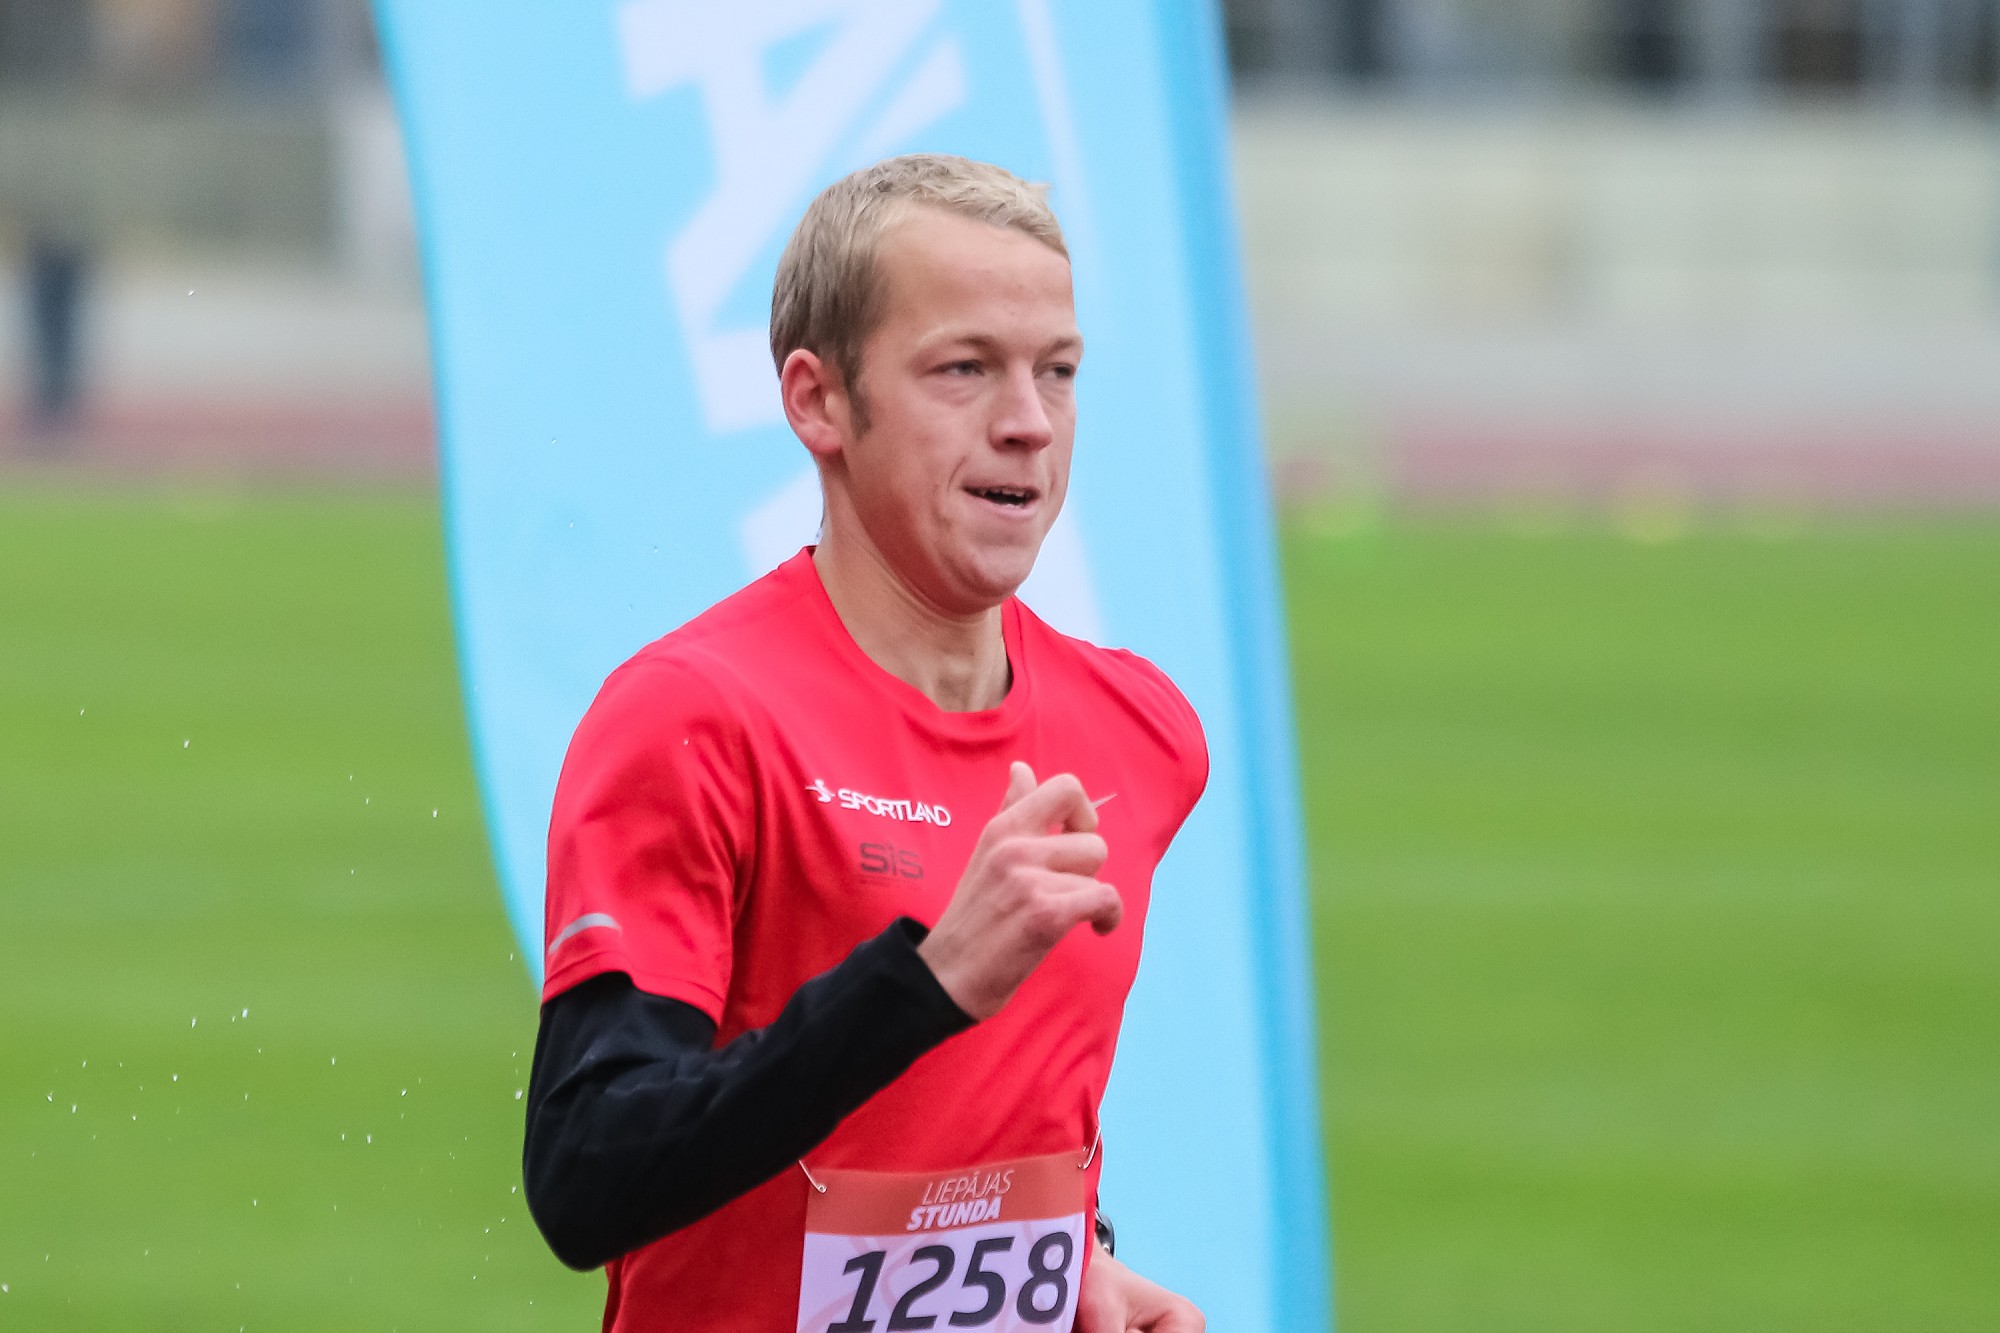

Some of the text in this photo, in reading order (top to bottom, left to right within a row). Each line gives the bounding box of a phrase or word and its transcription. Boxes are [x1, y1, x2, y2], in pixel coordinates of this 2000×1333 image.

[838, 788, 952, 828] SPORTLAND
[923, 1169, 1014, 1206] LIEPĀJAS
[907, 1197, 1002, 1231] STUNDA
[826, 1231, 1074, 1333] 1258
